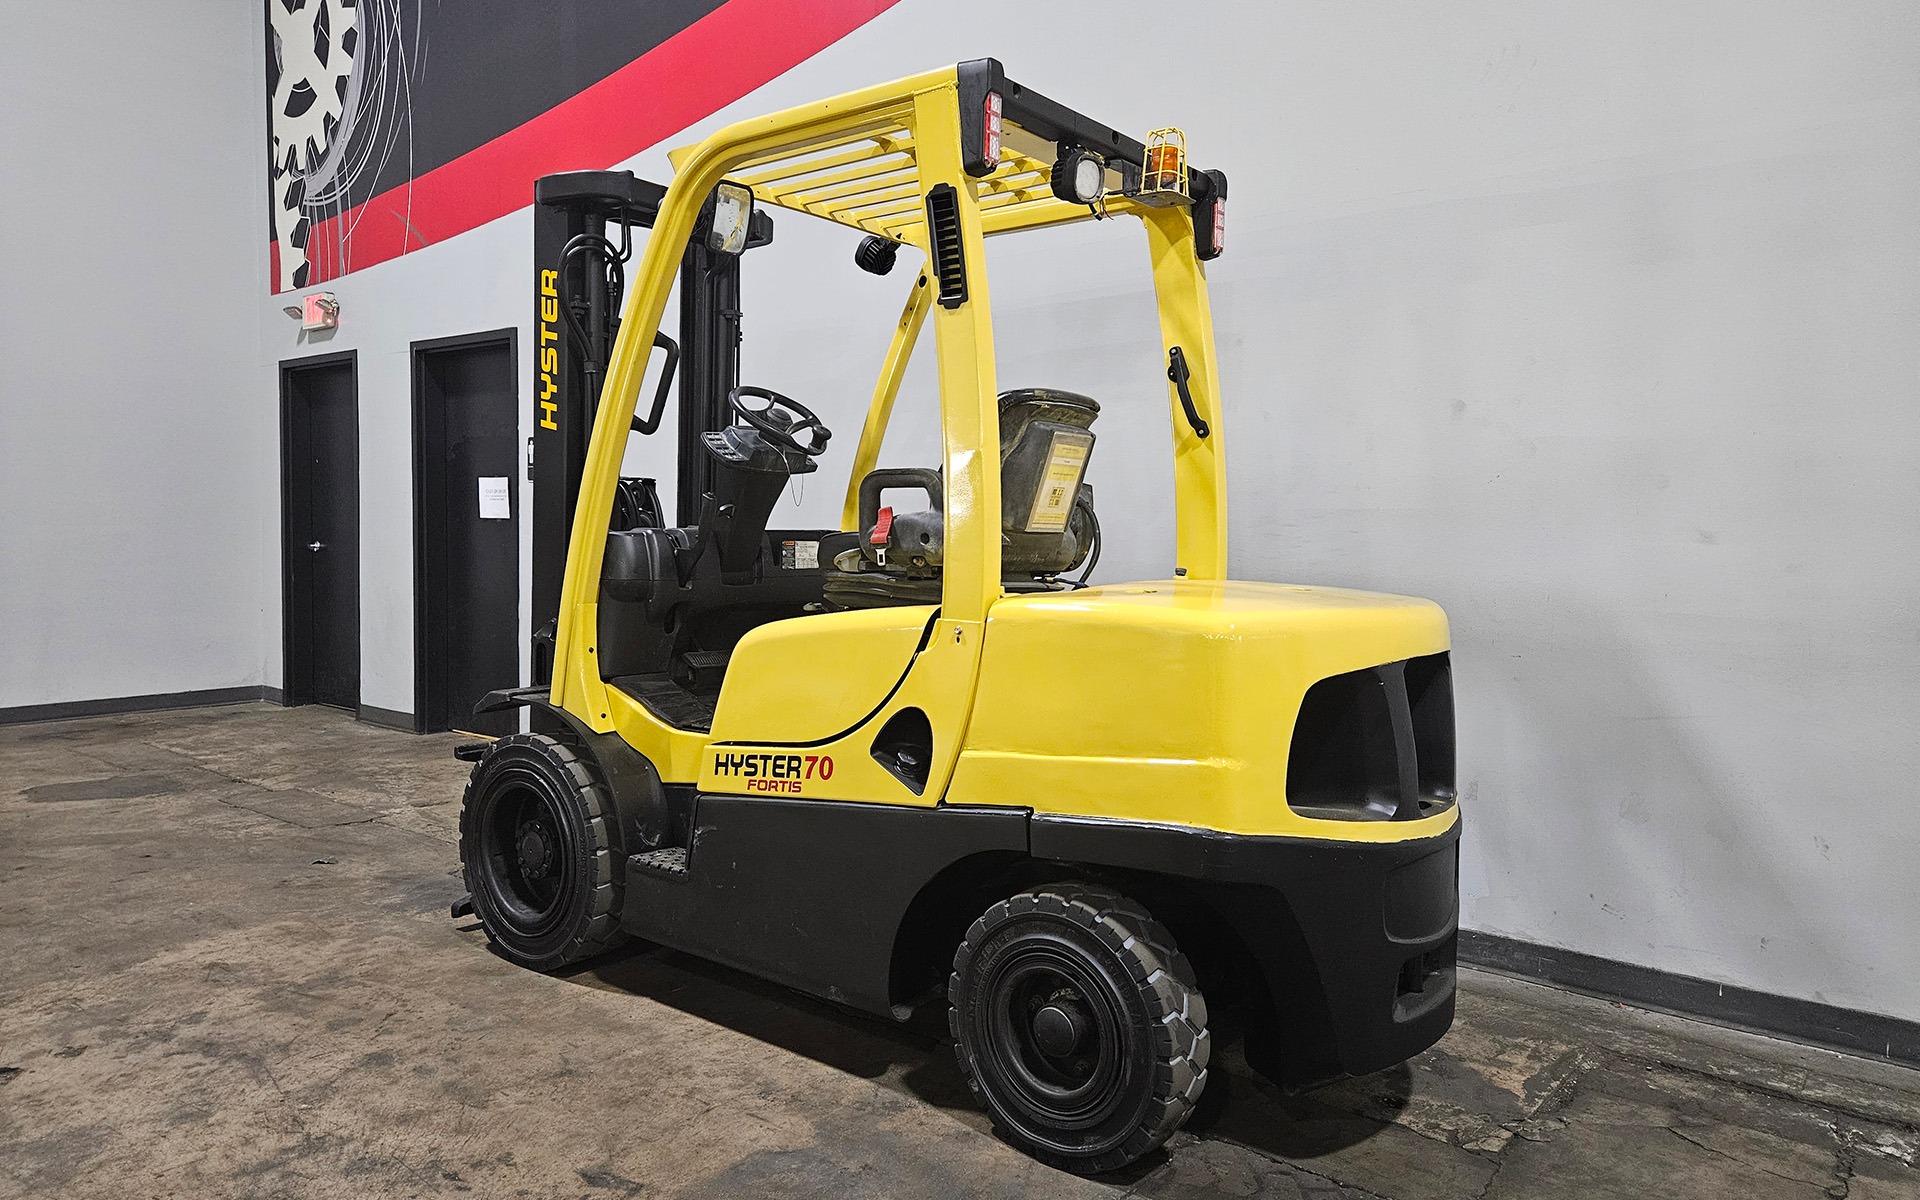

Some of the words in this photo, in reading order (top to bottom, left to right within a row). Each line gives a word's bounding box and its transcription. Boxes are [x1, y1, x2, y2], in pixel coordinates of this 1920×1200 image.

[540, 269, 559, 431] HYSTER
[714, 753, 802, 779] HYSTER
[804, 755, 834, 781] 70
[747, 778, 802, 793] FORTIS
